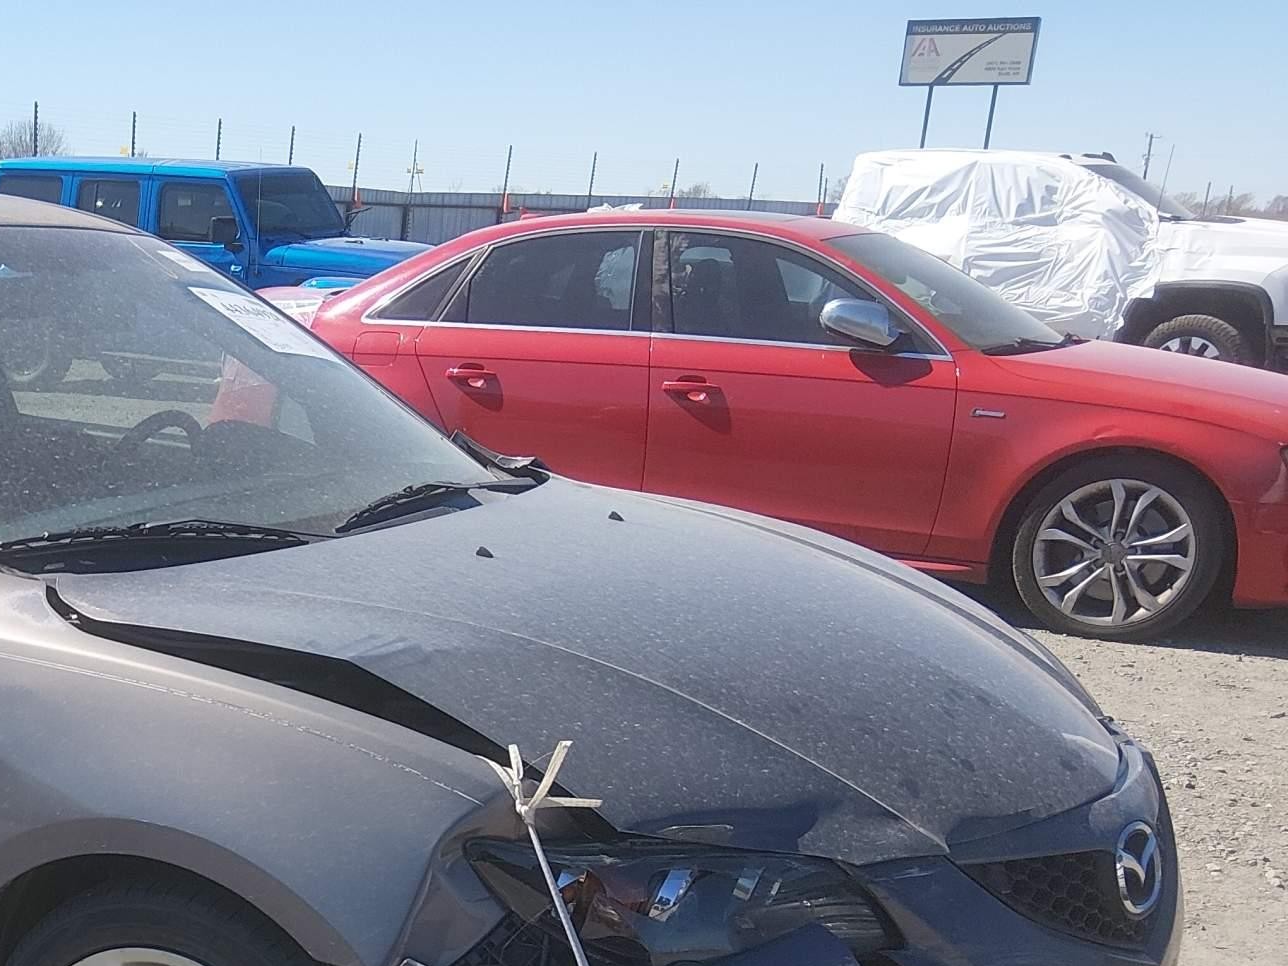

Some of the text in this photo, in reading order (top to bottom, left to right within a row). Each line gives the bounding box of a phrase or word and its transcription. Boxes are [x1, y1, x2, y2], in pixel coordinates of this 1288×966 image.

[912, 22, 1032, 33] INSURANCE AUTO AUCTIONS
